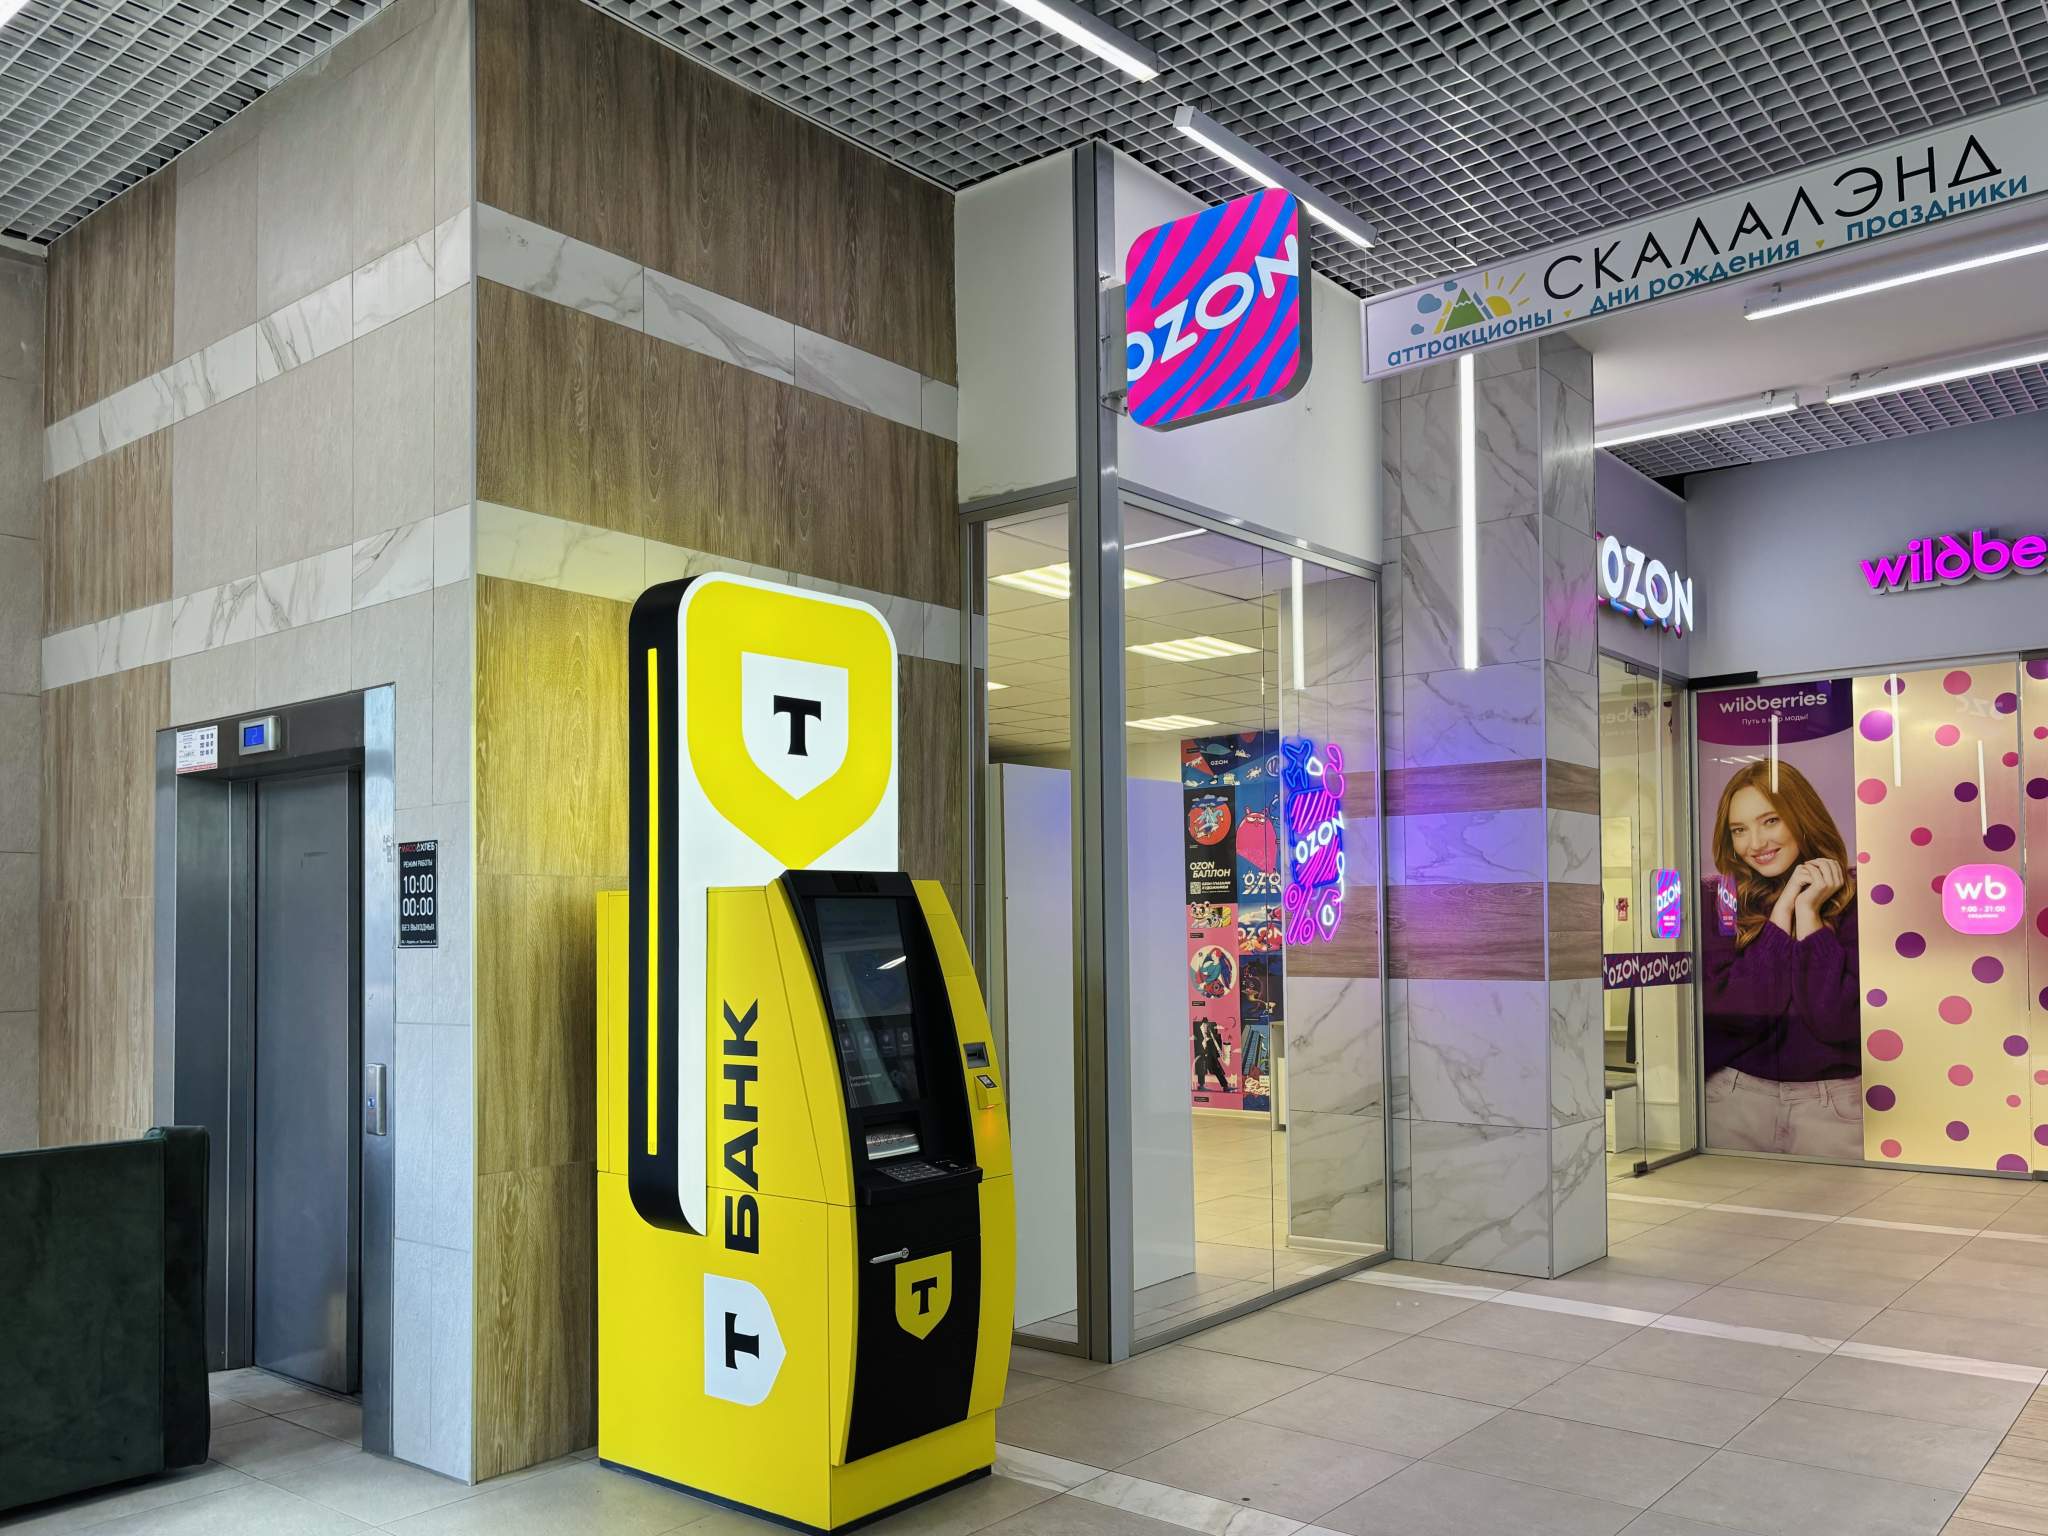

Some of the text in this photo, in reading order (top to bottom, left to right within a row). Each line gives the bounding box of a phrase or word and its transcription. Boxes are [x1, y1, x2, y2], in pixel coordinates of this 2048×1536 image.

[1543, 134, 2002, 300] СКАЛАЛЭНД
[1387, 174, 2028, 367] аттракционы дни рождения праздники
[1126, 233, 1299, 382] OZON
[1601, 535, 1694, 632] OZON
[1719, 691, 1828, 715] wildberries
[1742, 718, 1760, 726] Путь
[1296, 810, 1346, 864] OZON
[1189, 861, 1215, 871] OZON
[1192, 868, 1232, 879] БАЛЛОН
[403, 874, 434, 894] 10:00
[1656, 880, 1681, 912] OZON
[1954, 874, 2007, 901] wb
[402, 897, 434, 917] 00:00
[1608, 956, 1640, 987] OZON
[1640, 955, 1669, 984] OZON
[722, 998, 760, 1255] БАНК
